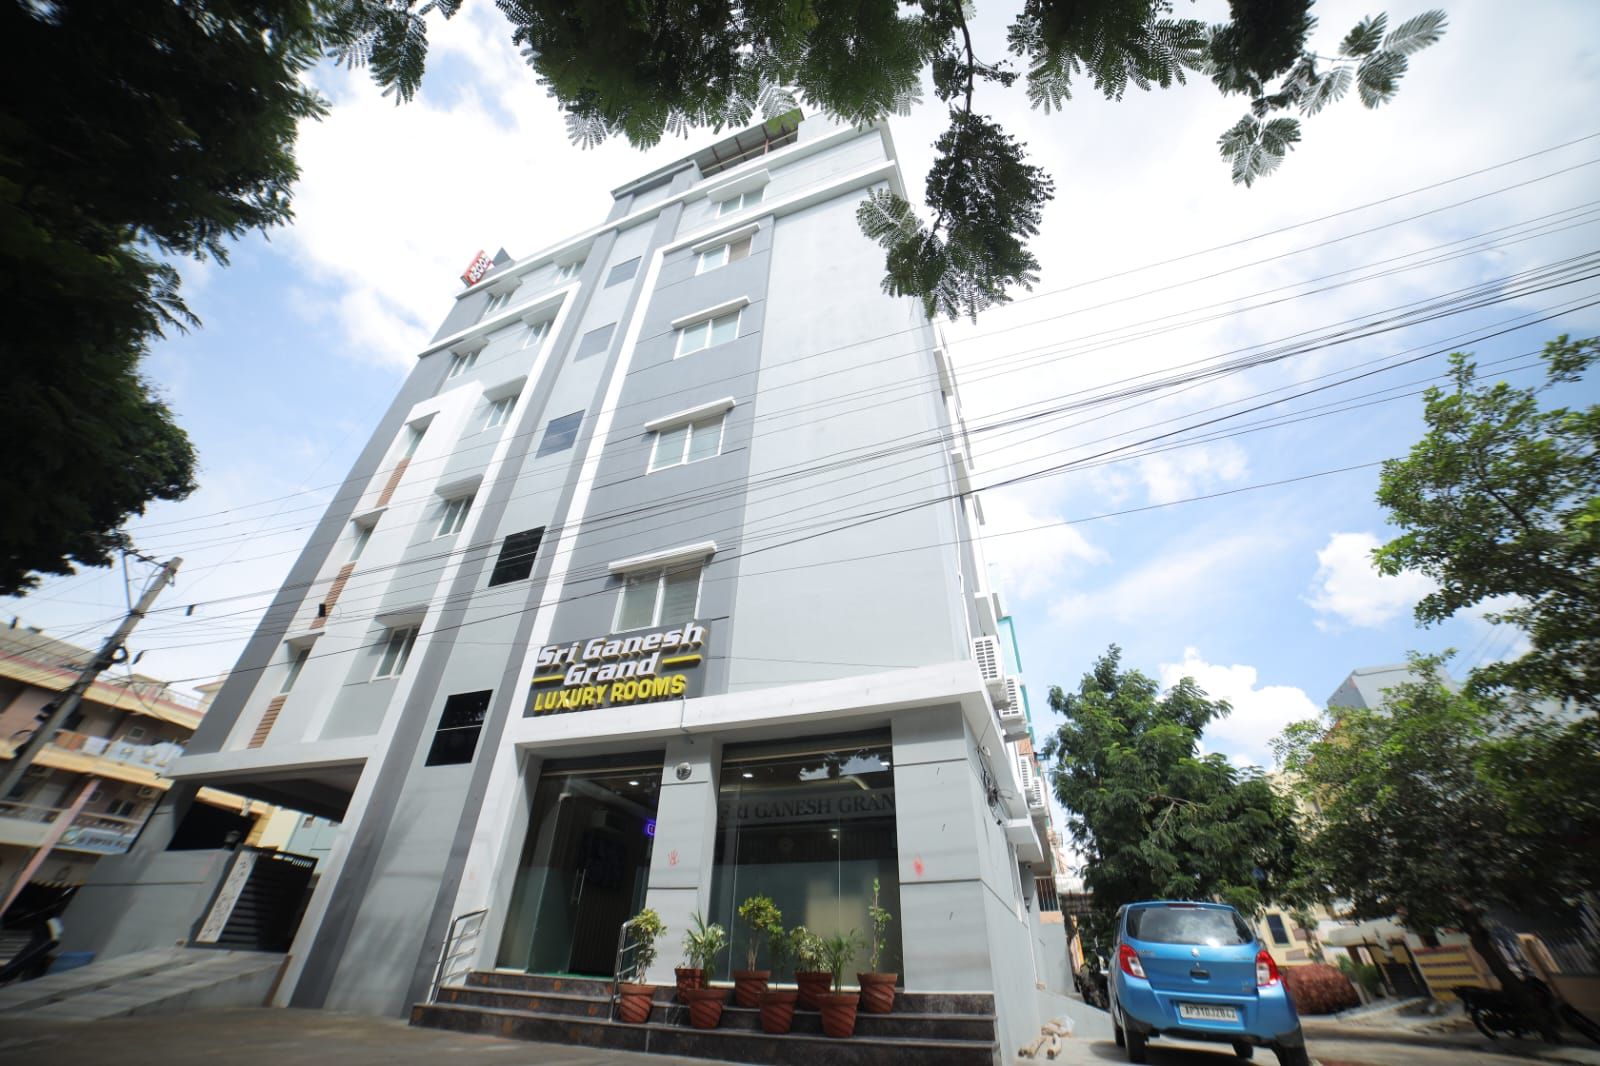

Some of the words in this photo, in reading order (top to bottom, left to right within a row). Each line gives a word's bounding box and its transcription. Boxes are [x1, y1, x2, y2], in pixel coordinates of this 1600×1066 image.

[536, 641, 581, 668] Sri
[582, 622, 706, 661] Ganesh
[564, 652, 661, 686] Grand
[534, 684, 609, 712] LUXURY
[610, 673, 688, 703] ROOMS
[755, 800, 831, 818] GANESH
